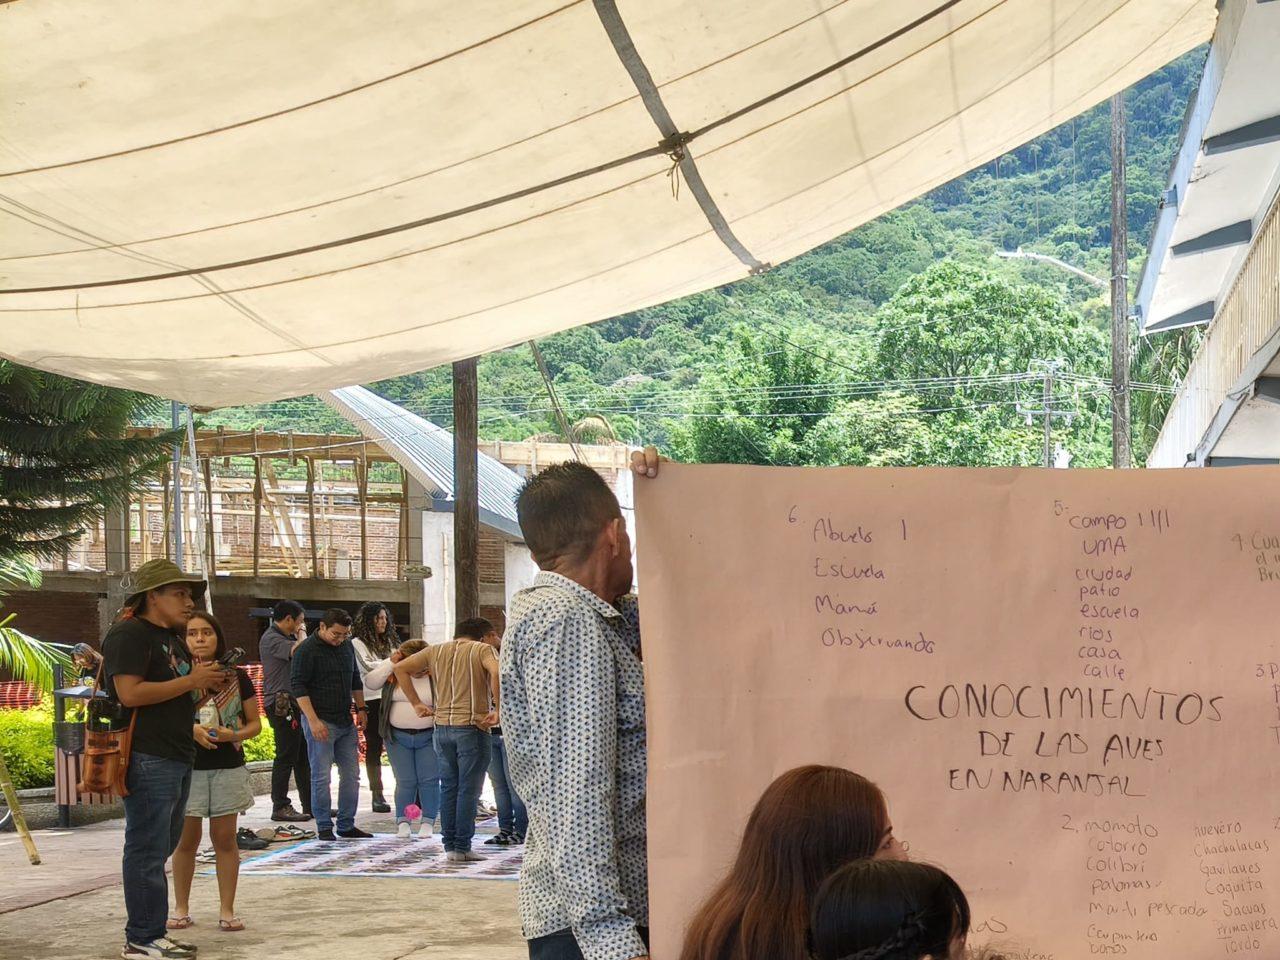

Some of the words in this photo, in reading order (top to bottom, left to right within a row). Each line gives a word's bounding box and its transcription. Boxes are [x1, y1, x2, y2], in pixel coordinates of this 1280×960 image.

[1076, 566, 1132, 581] ciudad
[1080, 583, 1120, 601] patio
[1080, 604, 1139, 619] escuela
[1078, 646, 1122, 660] casa
[1084, 664, 1124, 681] calle
[904, 683, 1224, 725] CONOCIMIENTOS
[978, 729, 1015, 757] DE
[1035, 731, 1088, 757] LAS
[1103, 734, 1163, 767] AVES
[949, 768, 993, 790] EN
[1003, 769, 1146, 796] NARANJAL
